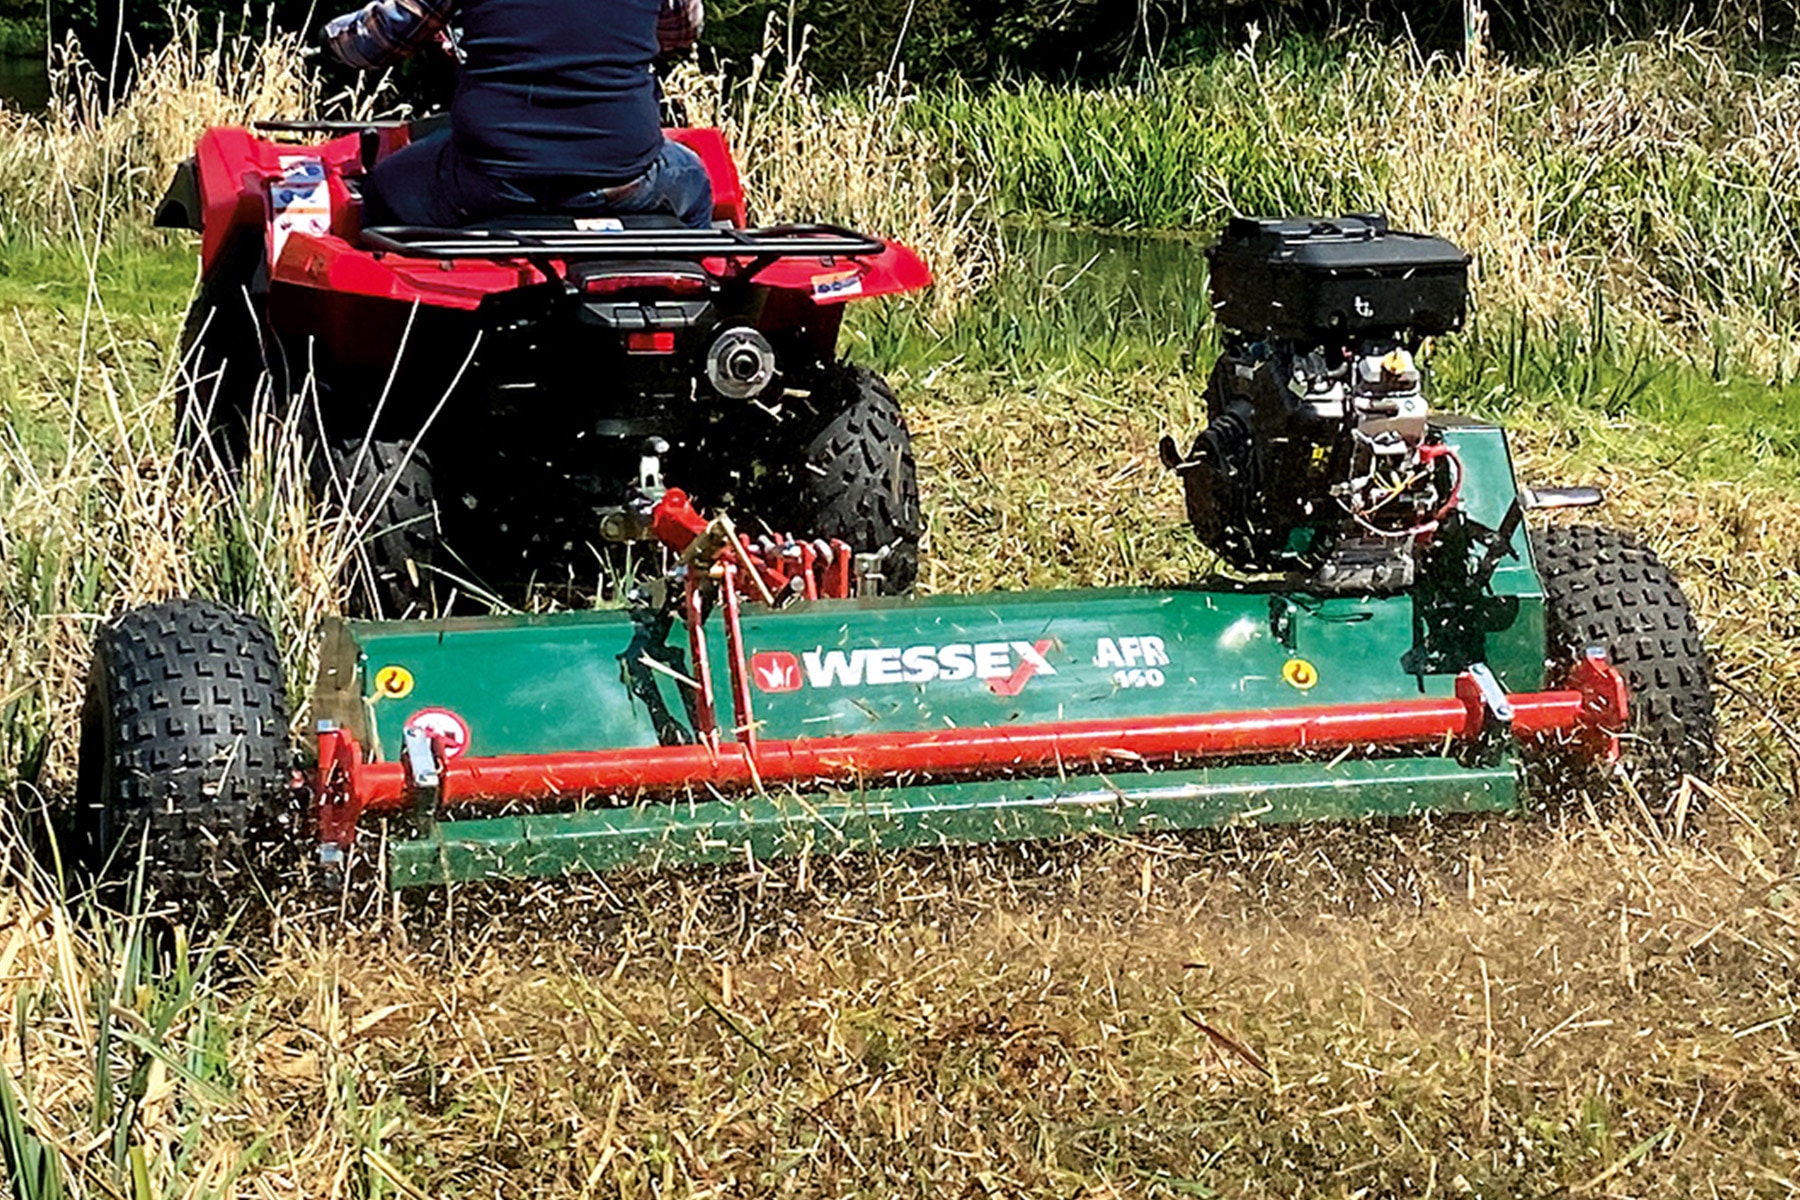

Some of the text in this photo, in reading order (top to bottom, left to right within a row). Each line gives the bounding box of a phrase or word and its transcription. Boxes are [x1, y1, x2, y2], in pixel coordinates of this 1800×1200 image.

[1093, 636, 1170, 667] AFR
[802, 640, 1057, 695] WESSEX
[1113, 668, 1165, 688] 160
